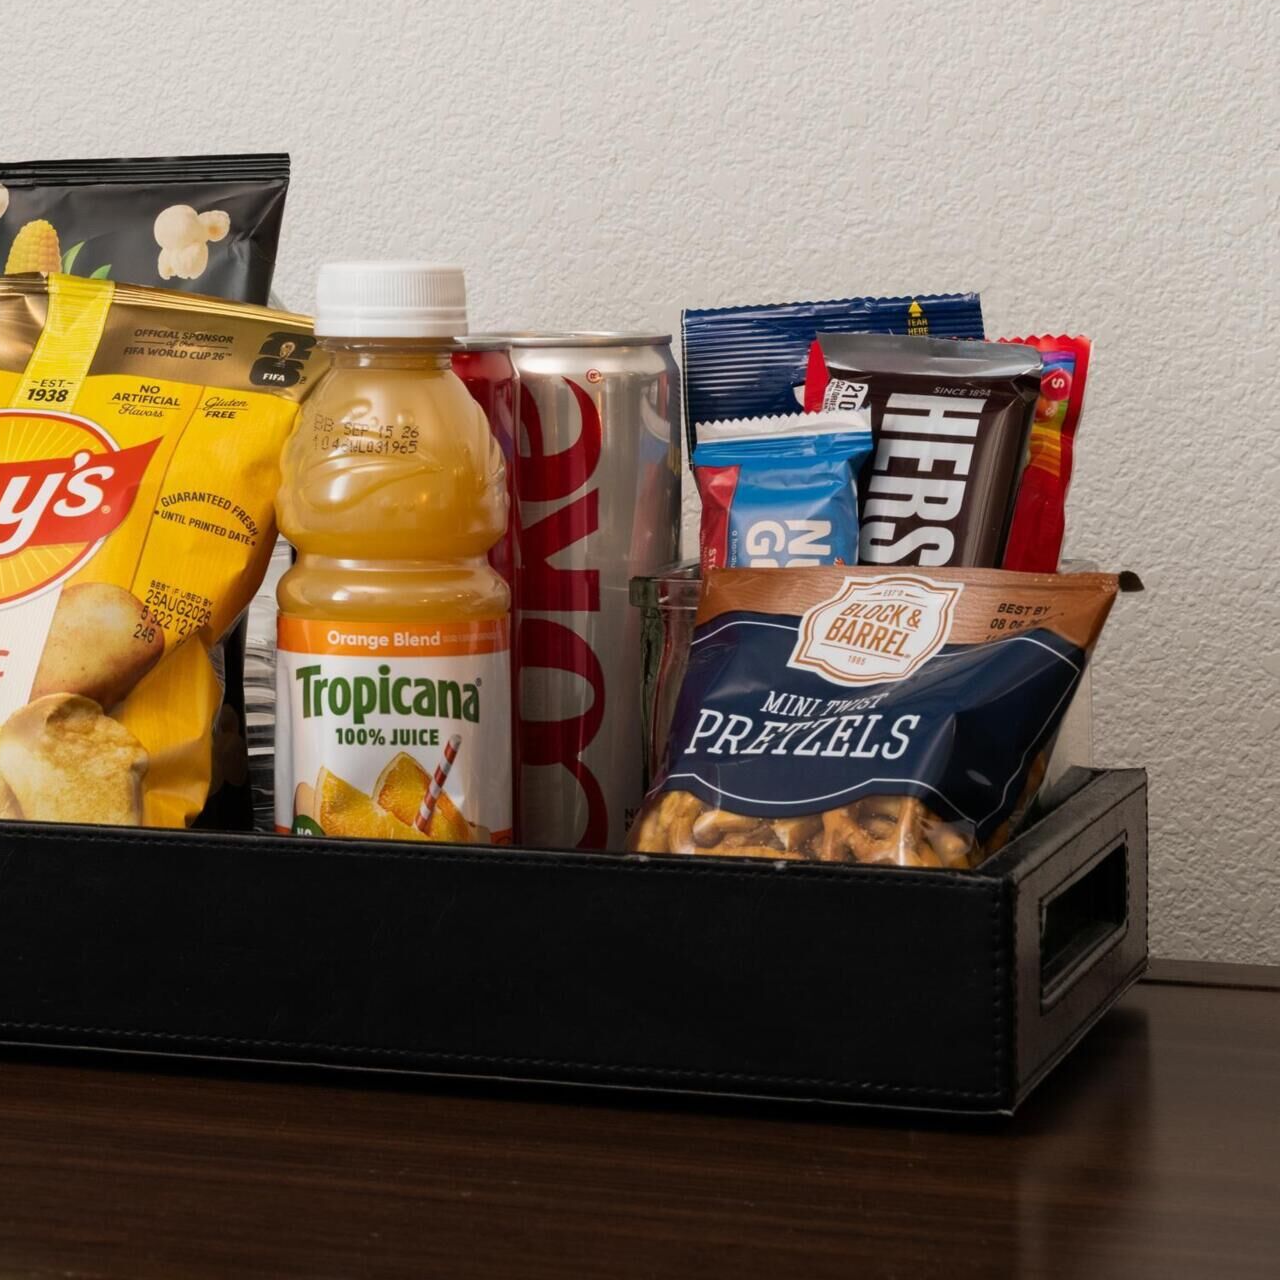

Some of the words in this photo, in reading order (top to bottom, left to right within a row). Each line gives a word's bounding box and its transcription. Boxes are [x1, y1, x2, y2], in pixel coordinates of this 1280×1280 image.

[134, 328, 179, 340] OFFICIAL
[183, 331, 234, 344] SPONSOR
[907, 326, 929, 336] HERE
[124, 346, 145, 357] FIFA
[147, 348, 187, 360] WORLD
[189, 351, 211, 361] CUP
[262, 373, 286, 382] FIFA
[27, 388, 69, 403] 1938
[140, 384, 160, 394] NO
[838, 384, 865, 410] 210
[933, 385, 967, 397] SINCE
[968, 389, 992, 398] 1894
[112, 393, 181, 406] ARTIFICIAL
[203, 396, 248, 411] Gluten
[118, 403, 164, 418] Flavors
[204, 410, 237, 419] FREE
[343, 421, 369, 437] SEP
[378, 425, 394, 440] 15
[401, 425, 420, 439] 26
[160, 491, 232, 511] GUARANTEED
[231, 505, 259, 536] FRESH
[161, 510, 186, 526] UNTIL
[188, 518, 226, 537] PRINTED
[227, 530, 251, 545] DATE
[150, 580, 170, 592] BEST
[181, 592, 202, 604] USED
[840, 603, 909, 628] BLOCK
[907, 609, 922, 629] &
[997, 603, 1032, 616] BEST
[1033, 606, 1051, 616] BY
[151, 609, 173, 630] 322
[327, 630, 389, 649] Orange
[393, 631, 440, 647] Blend
[824, 617, 910, 657] BARREL
[295, 664, 480, 725] Tropicana
[759, 691, 822, 717] MINI
[822, 693, 890, 717] TWIST
[336, 728, 385, 745] 100%
[390, 728, 439, 746] JUICE
[684, 708, 921, 760] PRETZELS
